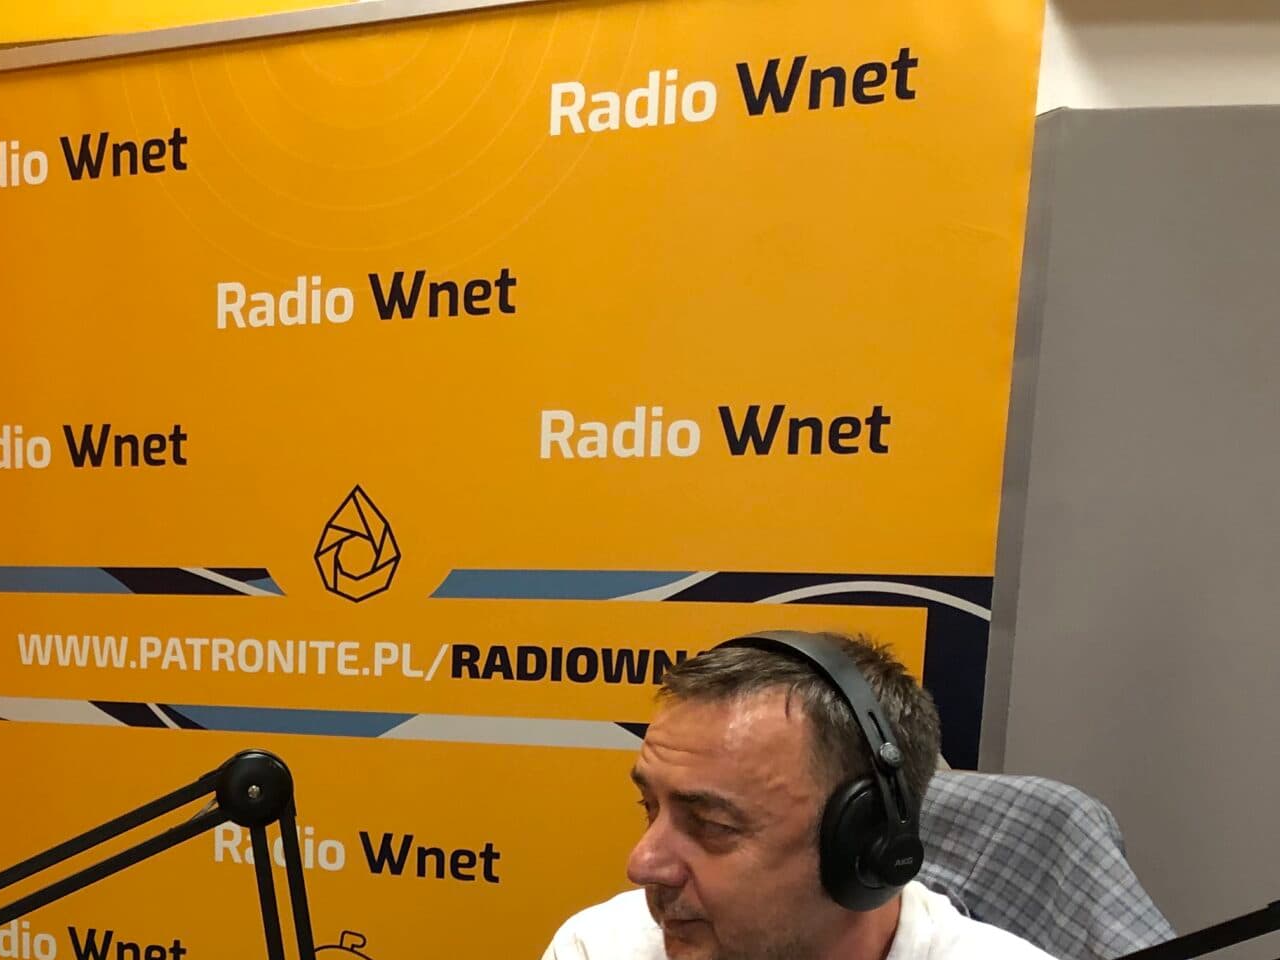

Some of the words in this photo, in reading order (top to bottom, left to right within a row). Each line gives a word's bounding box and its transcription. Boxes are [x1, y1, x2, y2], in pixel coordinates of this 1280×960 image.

[549, 68, 718, 137] Radio
[735, 47, 919, 116] Wnet
[59, 127, 188, 181] Wnet
[216, 275, 355, 329] Radio
[368, 267, 517, 320] Wnet
[62, 423, 188, 468] Wnet
[539, 405, 702, 459] Radio
[717, 404, 891, 457] Wnet
[18, 633, 710, 686] WWW.PATRONITE.PL/RADIOWN
[359, 831, 501, 883] Wnet
